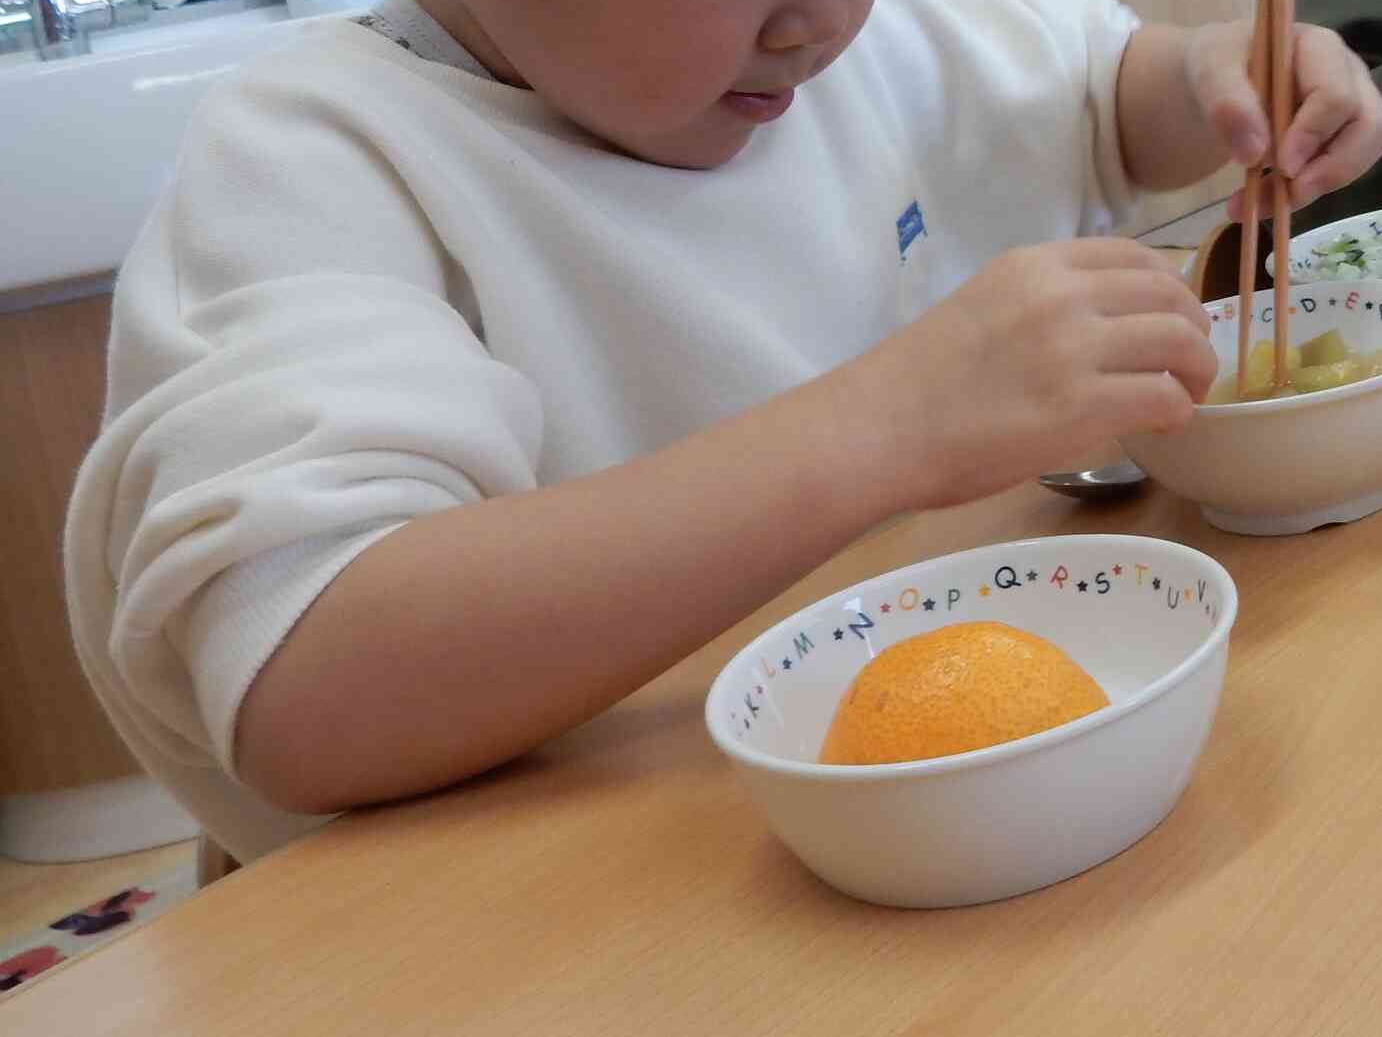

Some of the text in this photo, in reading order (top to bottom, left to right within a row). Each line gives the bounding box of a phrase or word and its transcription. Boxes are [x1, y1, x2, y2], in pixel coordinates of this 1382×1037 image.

[1261, 307, 1273, 323] C
[1300, 298, 1317, 313] D
[1344, 291, 1360, 310] E
[744, 693, 759, 719] K
[793, 632, 815, 659] M
[848, 612, 875, 640] N
[899, 588, 919, 611] O
[947, 588, 961, 612] P
[994, 566, 1023, 590] Q
[1050, 565, 1069, 590] R
[1095, 571, 1111, 595] S
[1134, 563, 1149, 587] T
[1167, 586, 1179, 610] U
[1197, 579, 1206, 604] V
